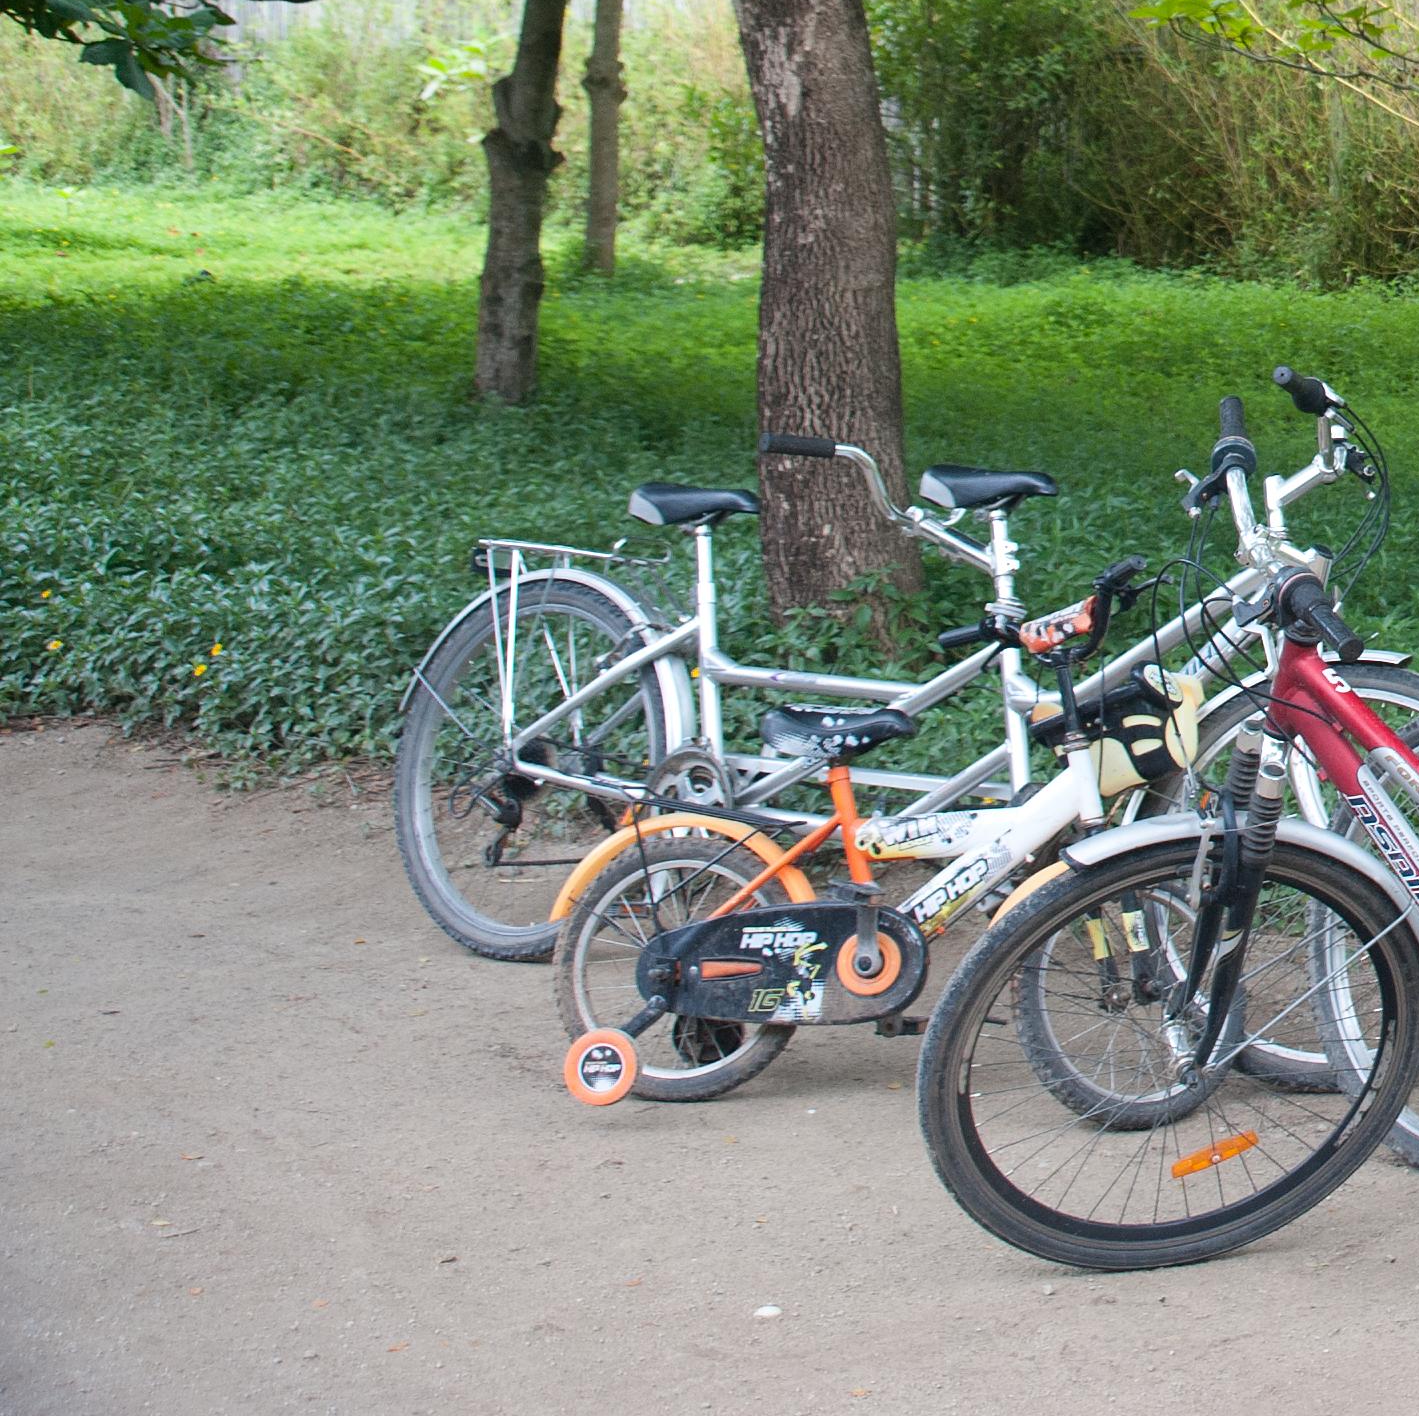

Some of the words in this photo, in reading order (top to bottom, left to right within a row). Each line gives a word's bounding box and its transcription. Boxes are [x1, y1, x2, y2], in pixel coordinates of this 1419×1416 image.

[913, 887, 949, 924] HIP
[945, 858, 989, 901] HOP
[739, 932, 774, 949] HIP
[773, 931, 818, 948] HOP
